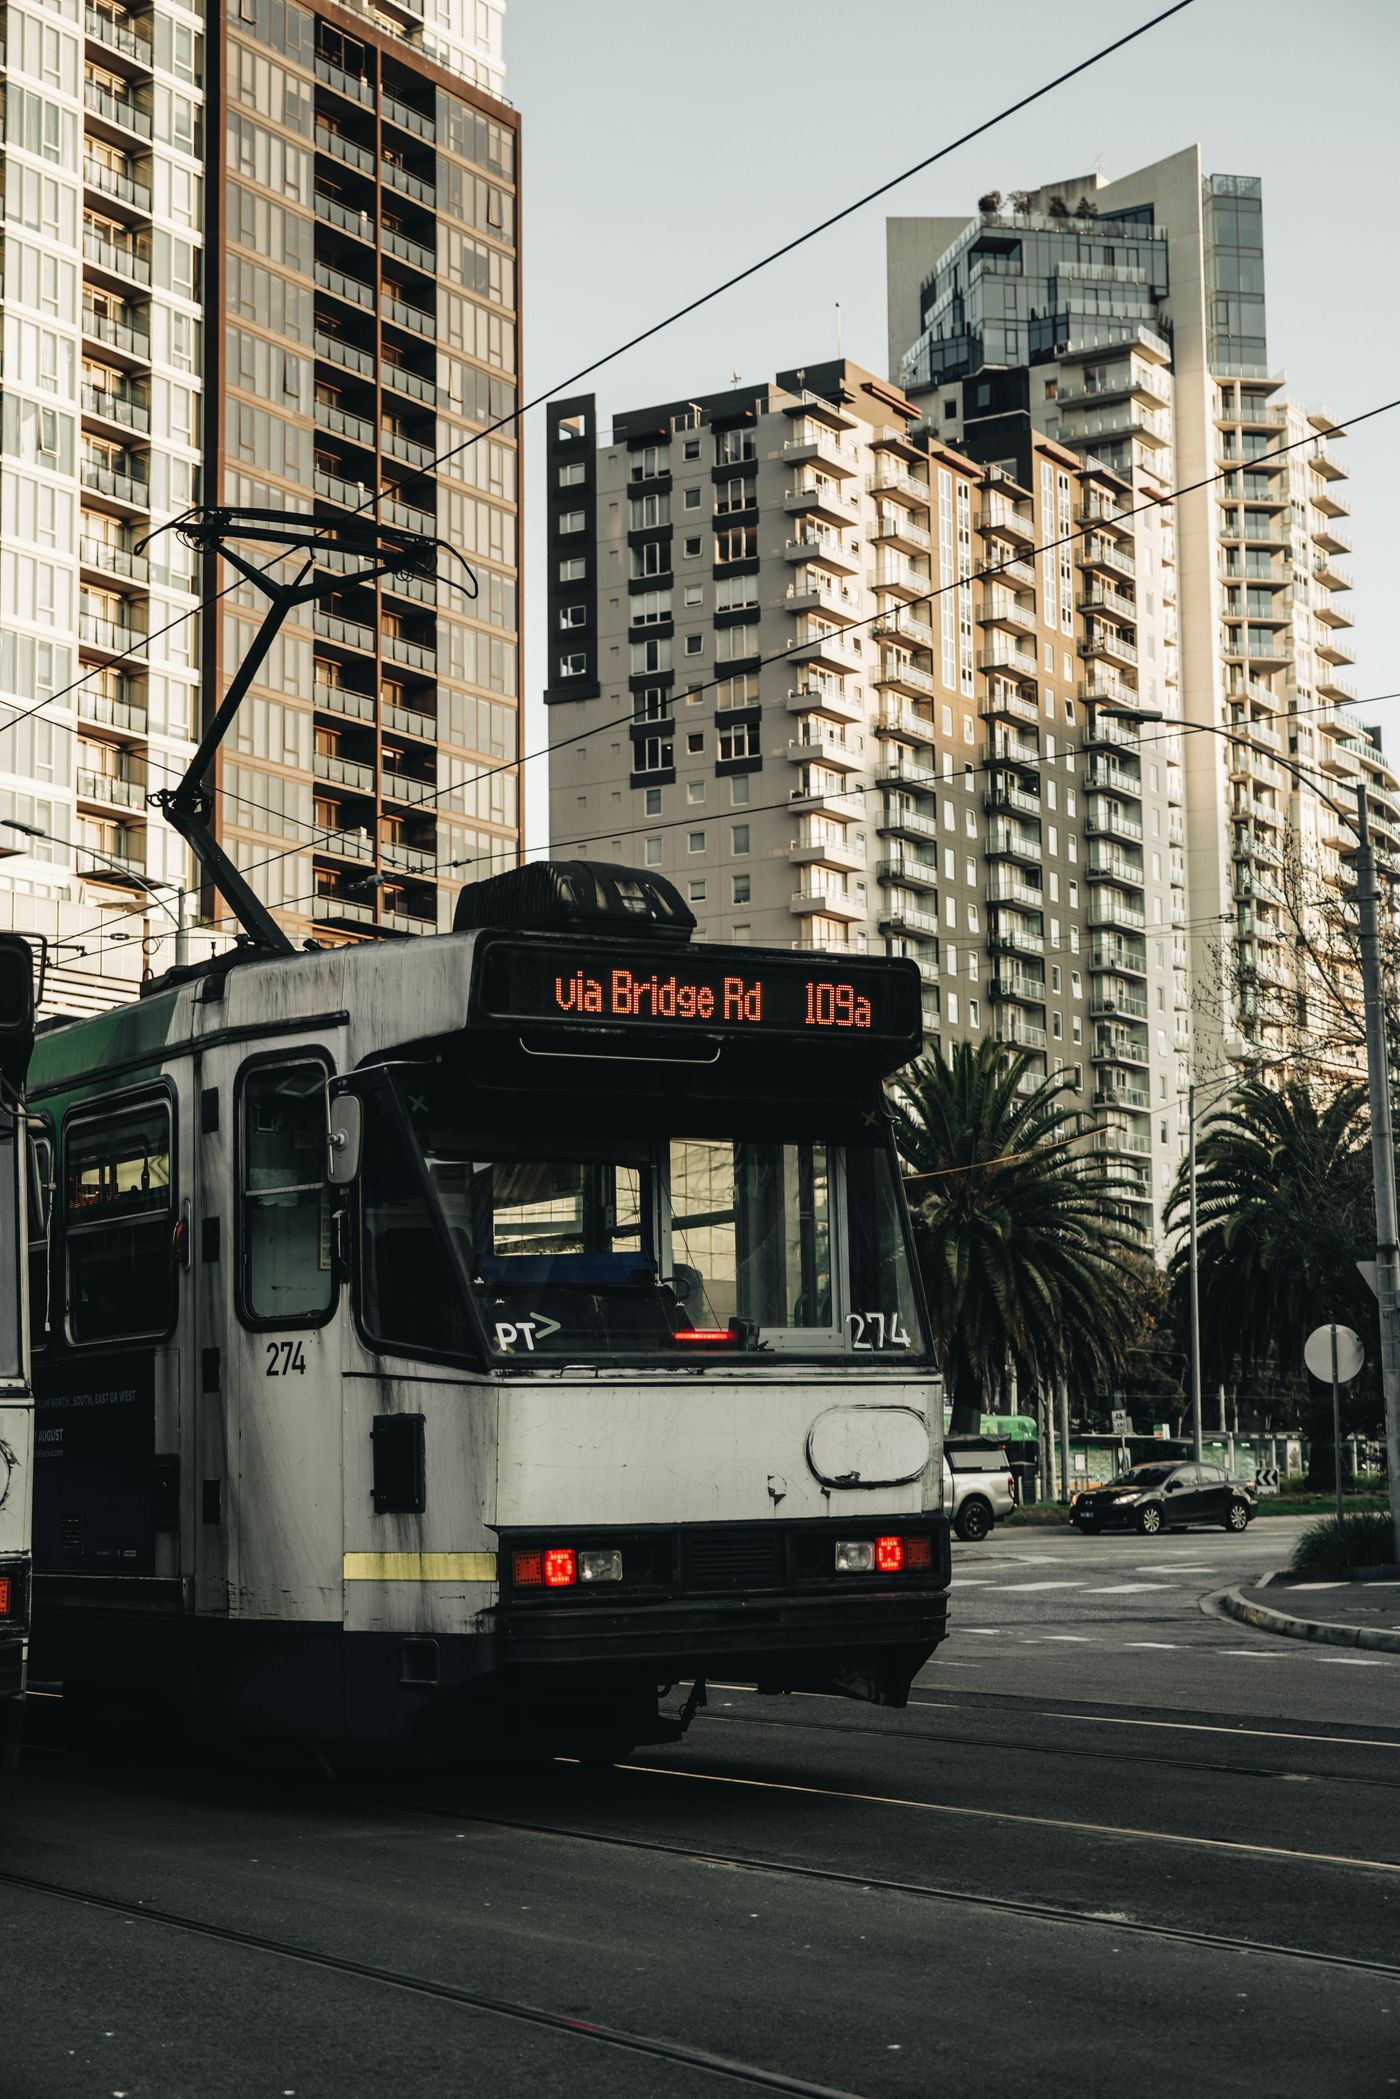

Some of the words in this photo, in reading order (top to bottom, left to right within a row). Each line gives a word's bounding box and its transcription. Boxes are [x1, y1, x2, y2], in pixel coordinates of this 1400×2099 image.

[555, 970, 602, 1012] via
[612, 970, 714, 1018] Bridge
[724, 977, 761, 1021] Rd
[805, 982, 871, 1028] 109a
[846, 1312, 911, 1350] 274
[266, 1341, 306, 1376] 274
[95, 1392, 109, 1405] EAST
[110, 1390, 118, 1403] OR
[119, 1389, 136, 1402] WEST
[38, 1428, 64, 1442] AUGUST
